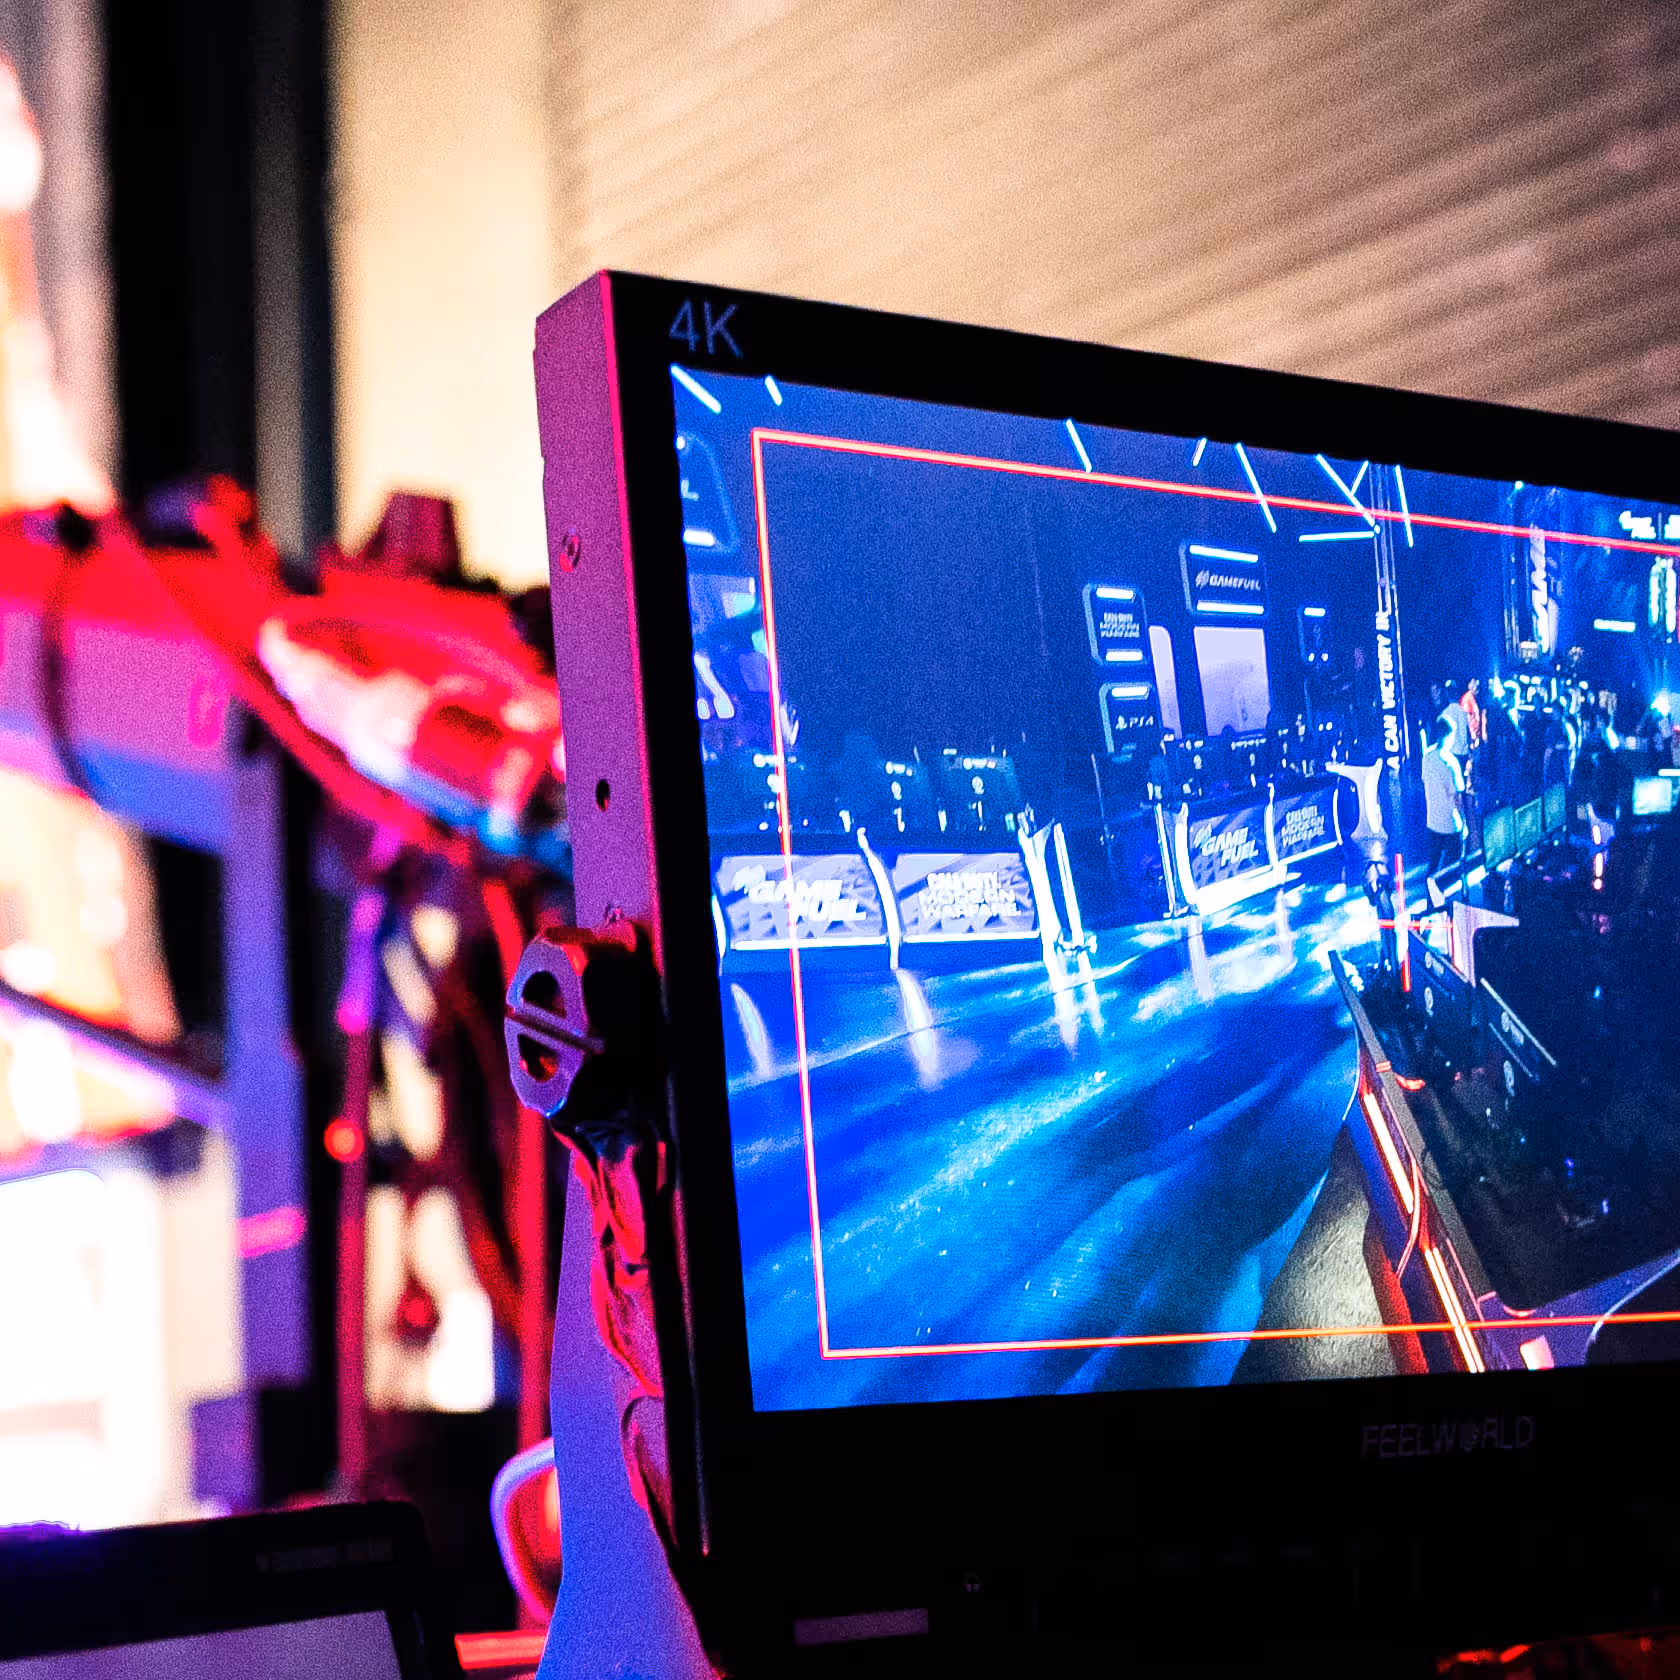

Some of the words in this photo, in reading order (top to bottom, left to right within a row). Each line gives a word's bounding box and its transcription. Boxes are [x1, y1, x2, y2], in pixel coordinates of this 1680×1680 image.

[668, 296, 744, 360] 4K
[1201, 827, 1249, 857] GAME
[1221, 840, 1259, 867] FUEL
[746, 880, 843, 903] GAME
[1361, 1412, 1535, 1462] FEELWORLD
